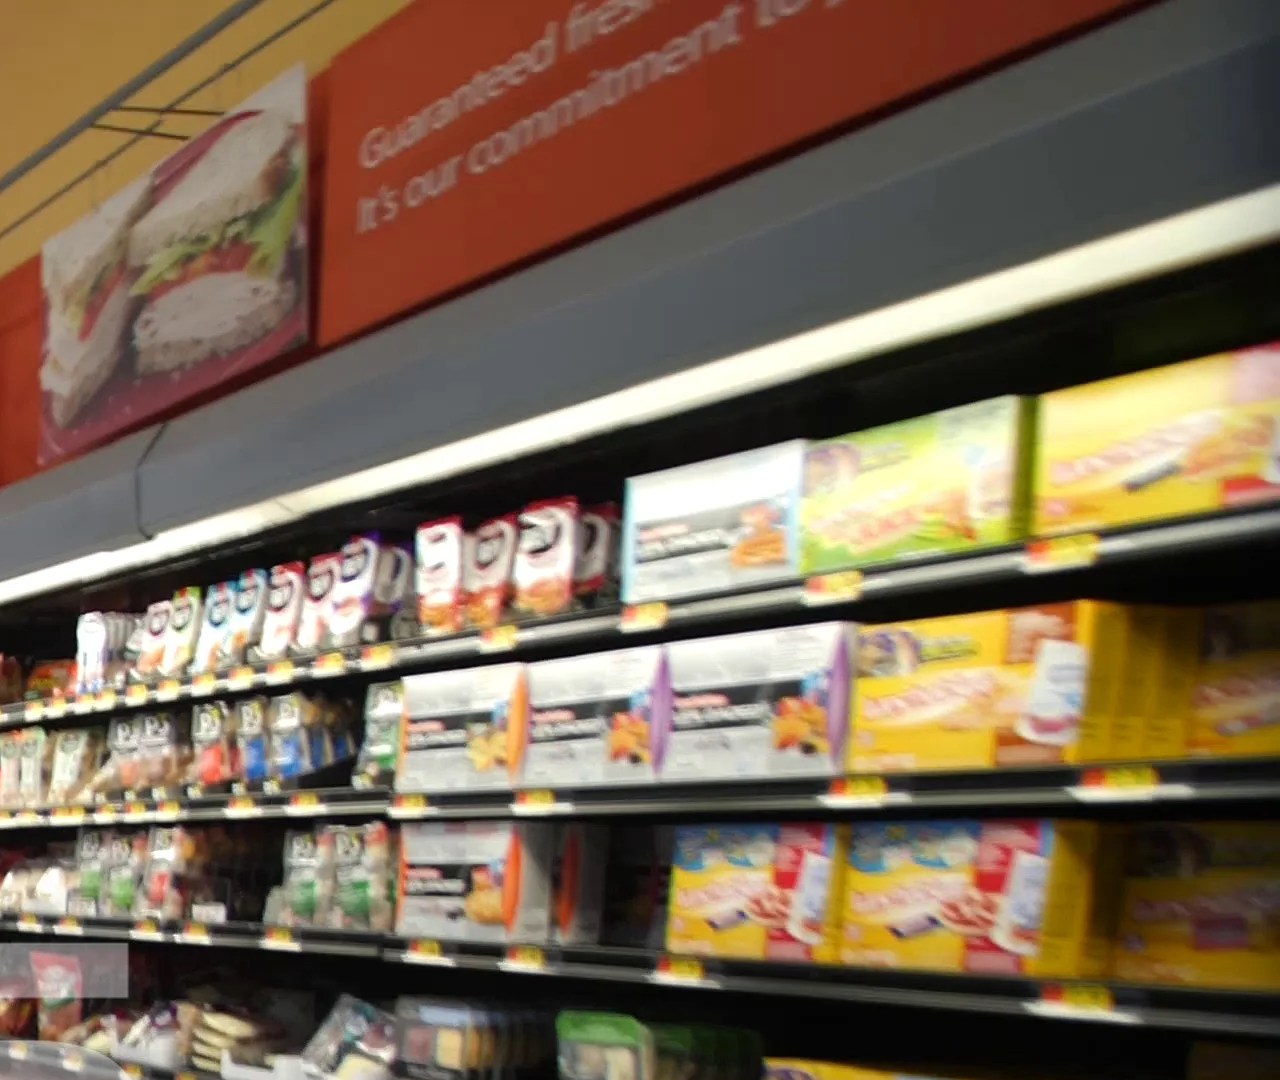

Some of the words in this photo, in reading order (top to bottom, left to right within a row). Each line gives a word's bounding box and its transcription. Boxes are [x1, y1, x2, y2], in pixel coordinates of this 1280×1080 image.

[357, 184, 399, 234] It's
[402, 155, 464, 208] our
[466, 7, 743, 175] commitment
[358, 25, 557, 169] Guaranteed
